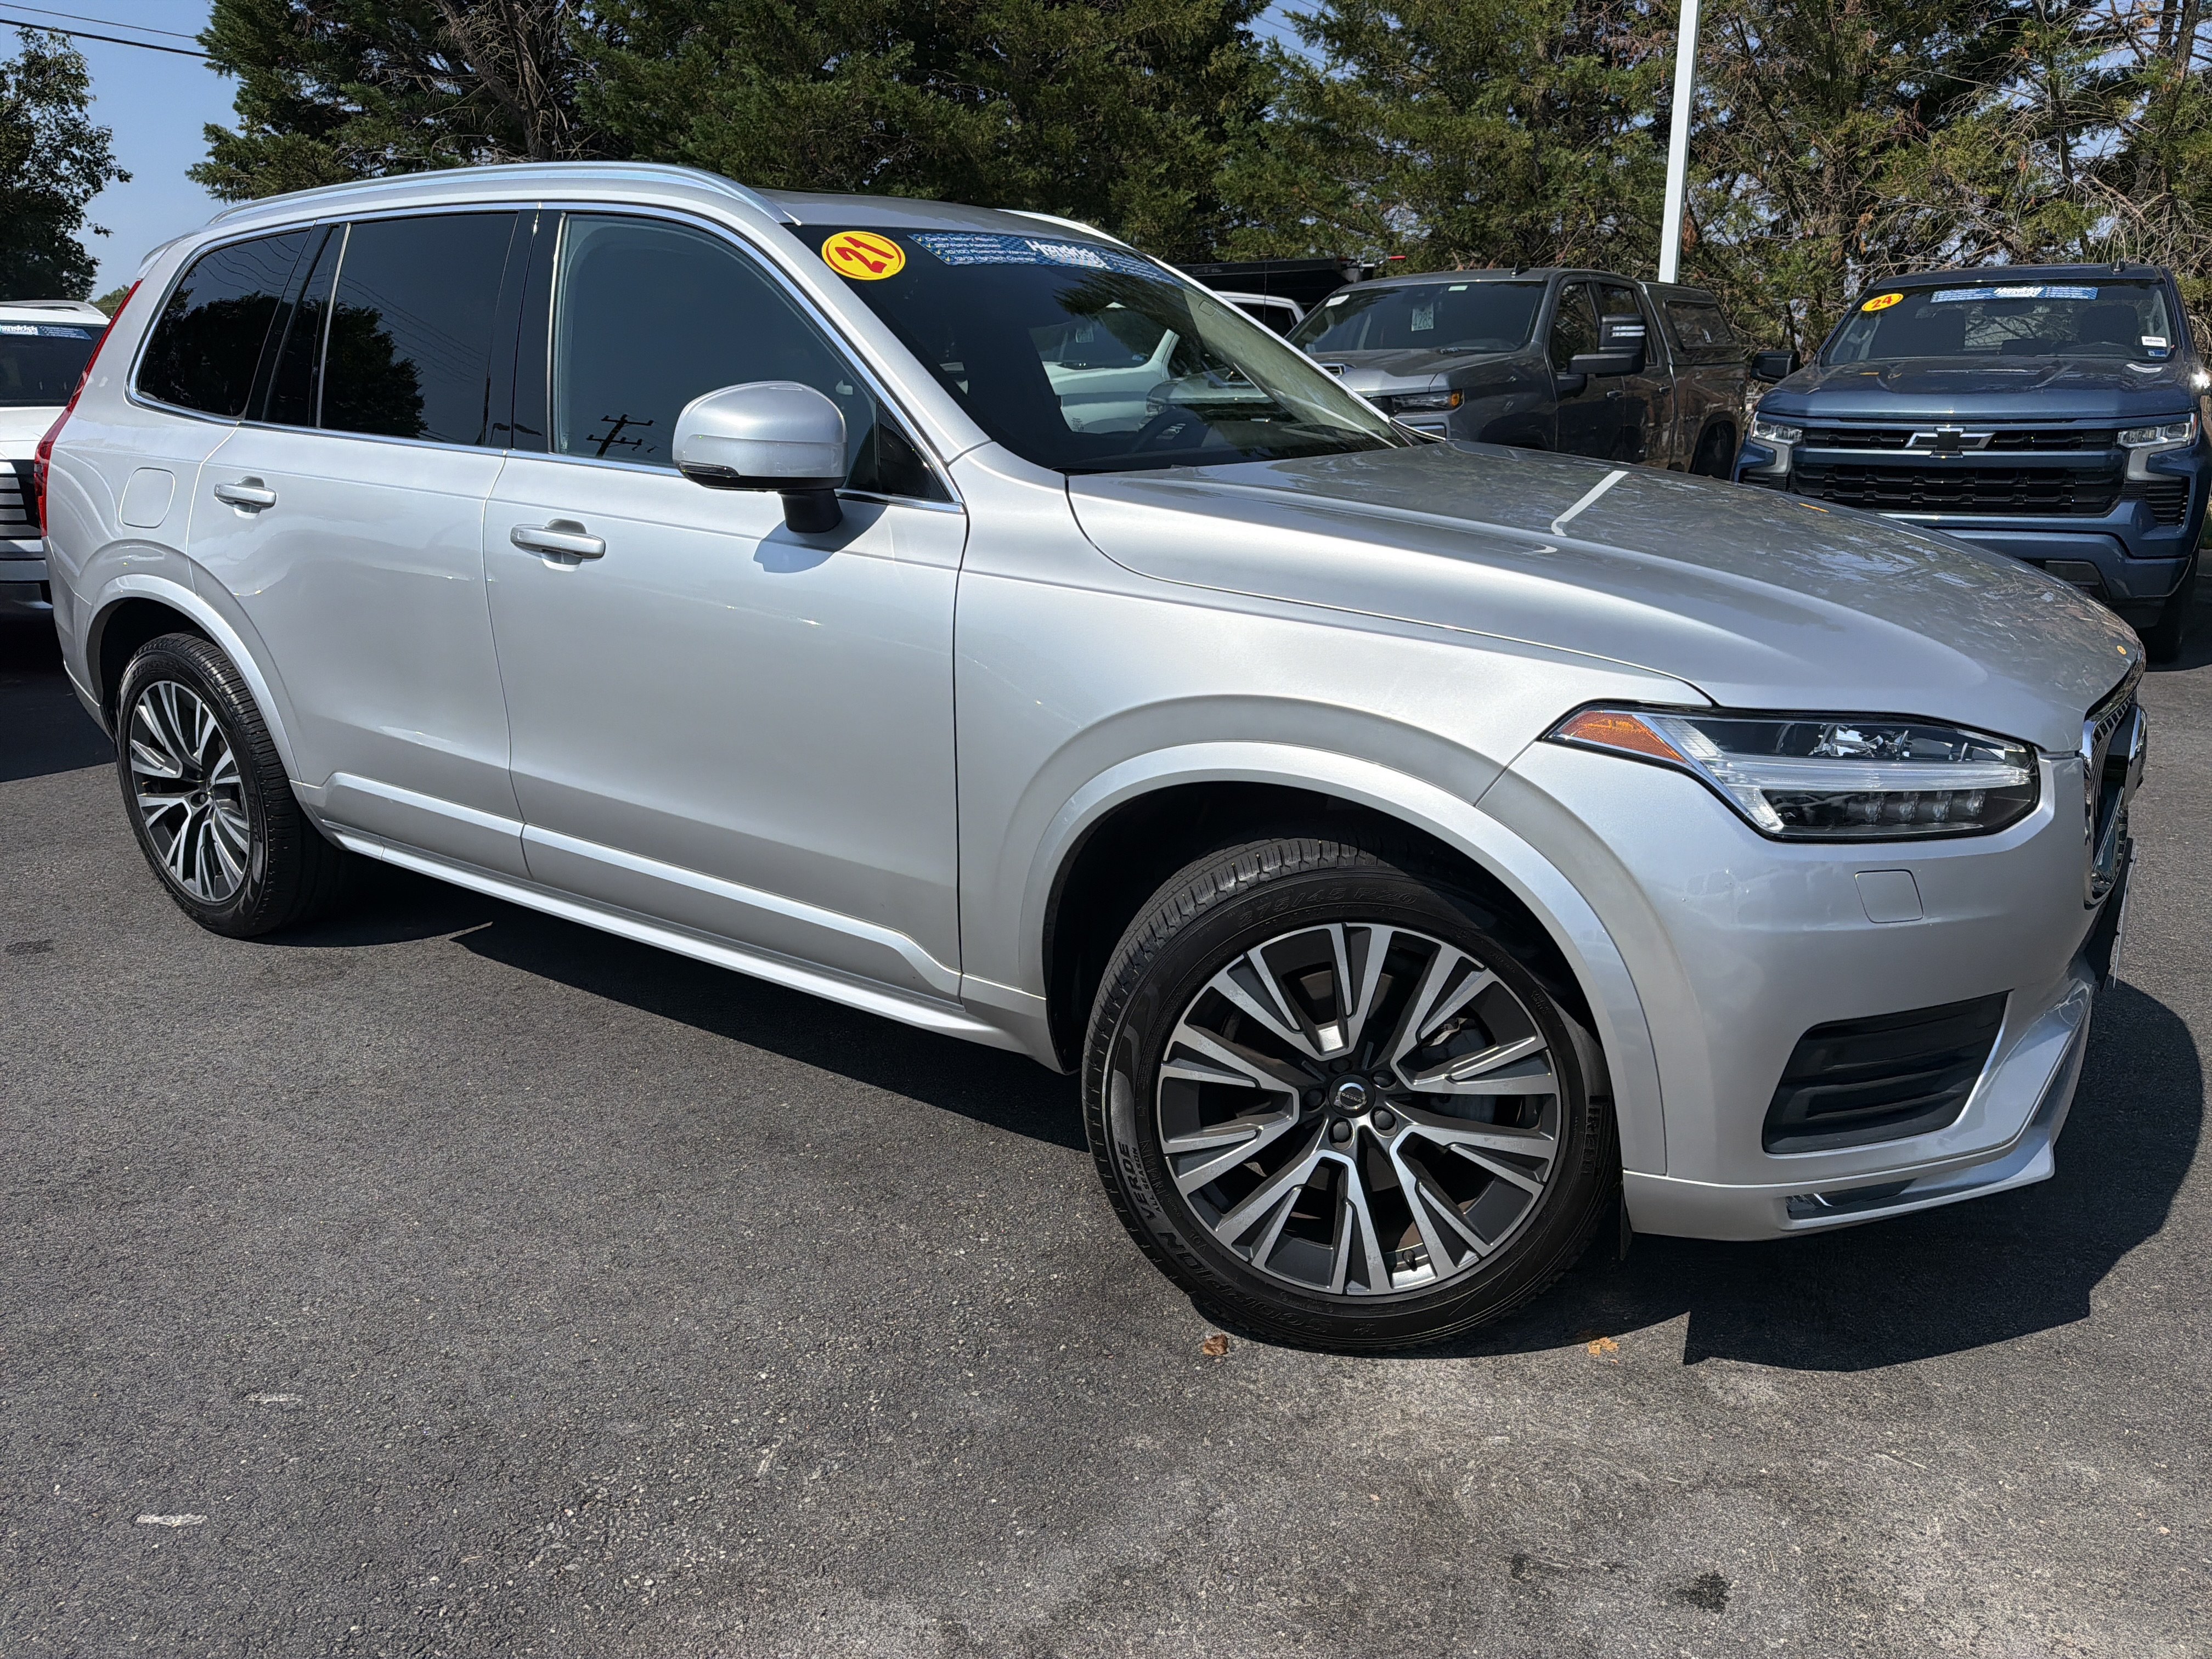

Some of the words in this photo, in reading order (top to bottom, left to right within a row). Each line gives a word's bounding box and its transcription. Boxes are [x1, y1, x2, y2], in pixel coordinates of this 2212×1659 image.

[834, 236, 895, 273] 21
[1024, 240, 1105, 265] Hendrick
[1871, 296, 1892, 309] 24
[1239, 888, 1346, 928] 275/45
[1118, 1141, 1157, 1221] VERDE
[1132, 1147, 1150, 1190] SEASON
[1150, 1194, 1163, 1213] ALL
